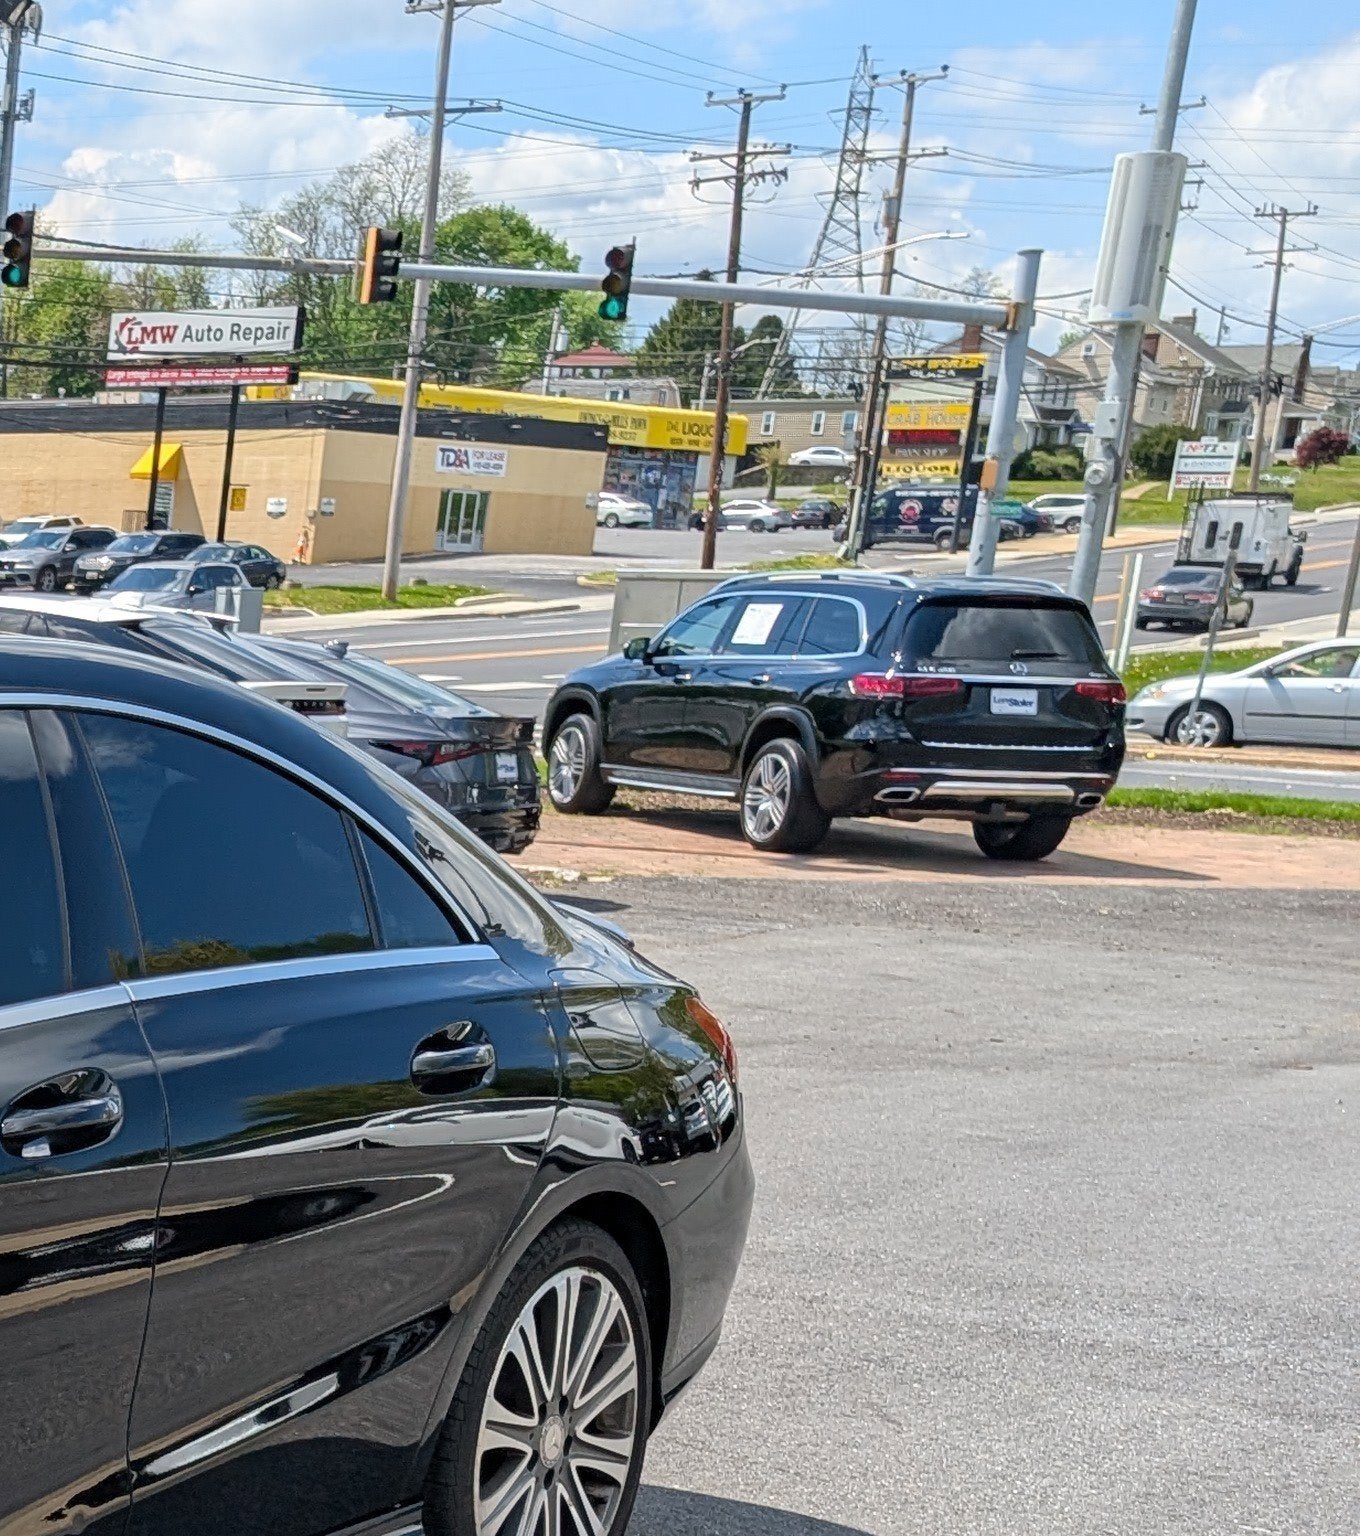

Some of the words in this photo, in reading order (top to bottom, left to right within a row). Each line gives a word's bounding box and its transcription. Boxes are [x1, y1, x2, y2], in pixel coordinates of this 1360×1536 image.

[126, 324, 178, 345] LMW
[181, 324, 224, 343] Auto
[229, 321, 291, 346] Repair
